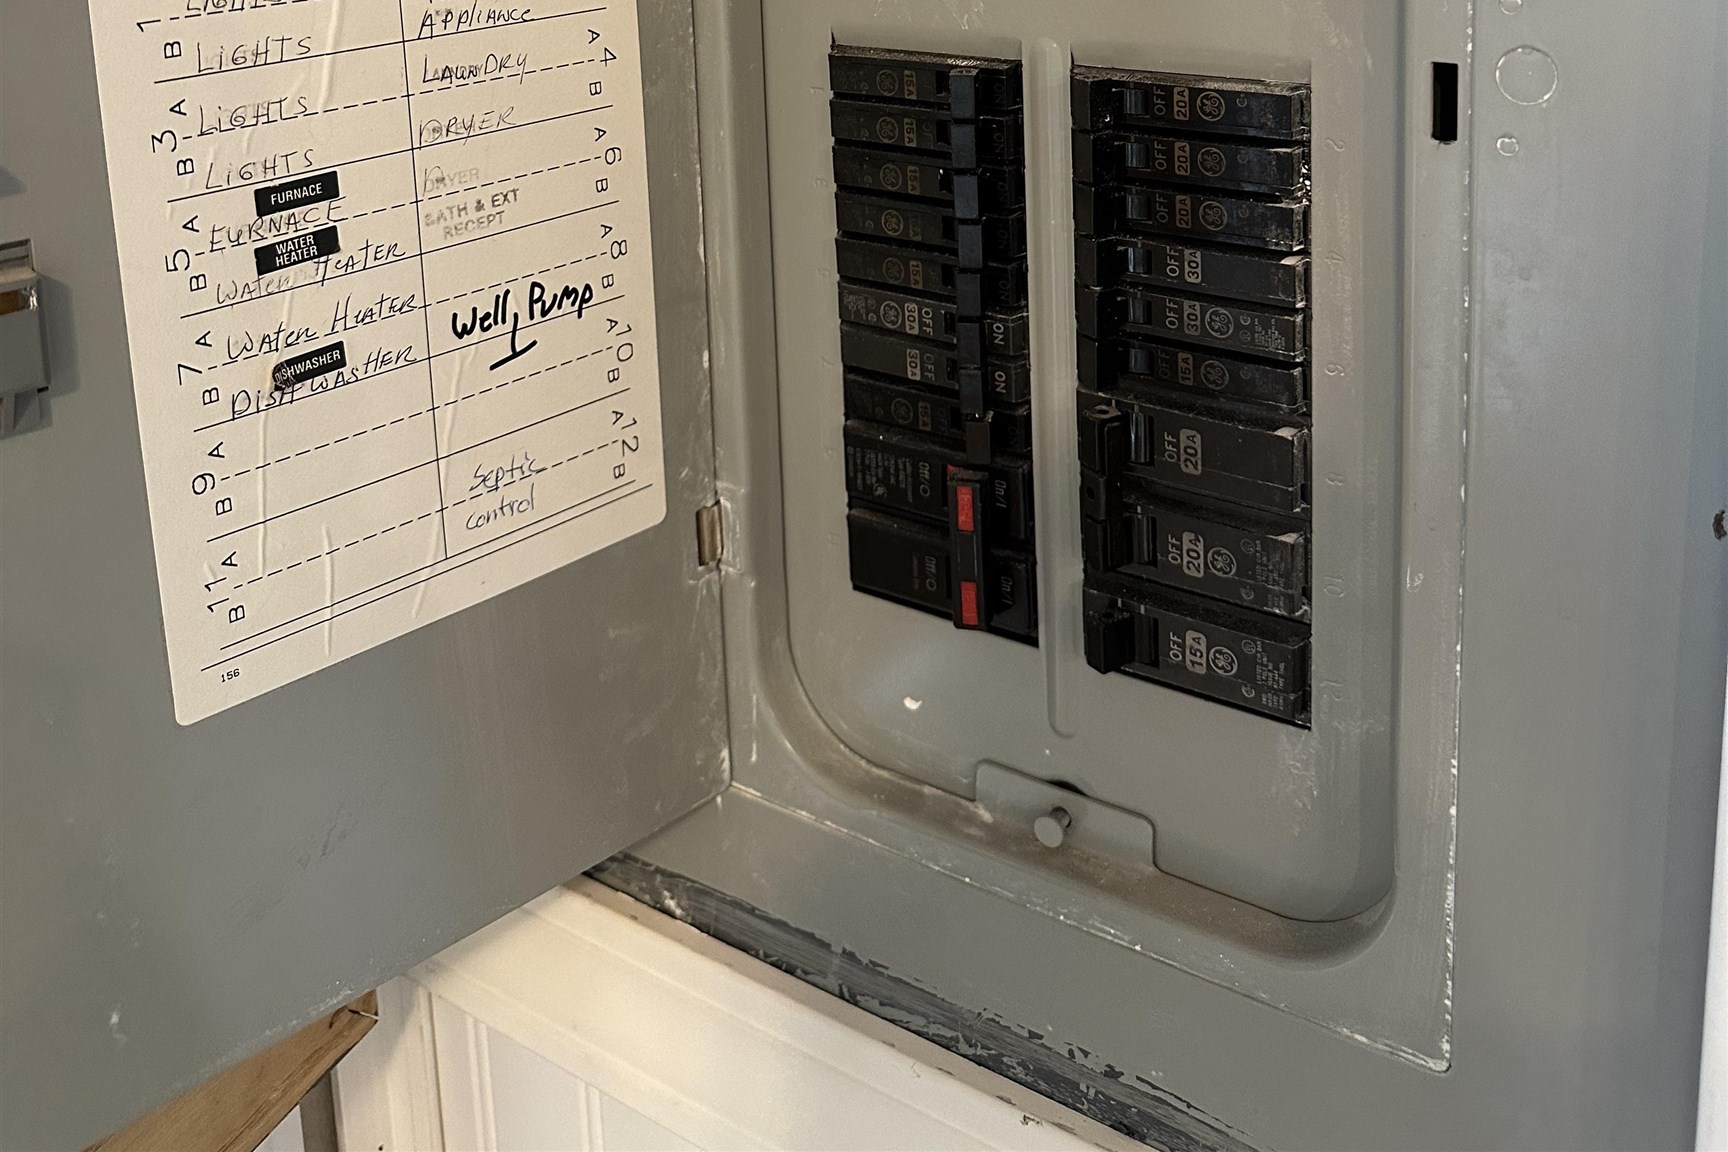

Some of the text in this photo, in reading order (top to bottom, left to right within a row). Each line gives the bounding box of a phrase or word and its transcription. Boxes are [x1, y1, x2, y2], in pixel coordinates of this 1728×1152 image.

[600, 47, 617, 67] 4
[1174, 89, 1188, 118] 20A
[1177, 146, 1188, 174] 20A
[271, 183, 323, 205] FURNACE
[491, 188, 519, 207] EXT
[275, 235, 315, 254] WATER
[275, 246, 318, 266] HEATER
[611, 239, 628, 259] 8
[1167, 248, 1200, 280] OFF 30A
[452, 289, 510, 339] Well
[907, 306, 1005, 346] 30A OFF ON
[994, 371, 1007, 394] ON
[1164, 432, 1198, 470] OFF 20A
[1169, 534, 1202, 573] OFF 20A
[1169, 632, 1204, 667] OFF 15A
[221, 668, 240, 683] 156
